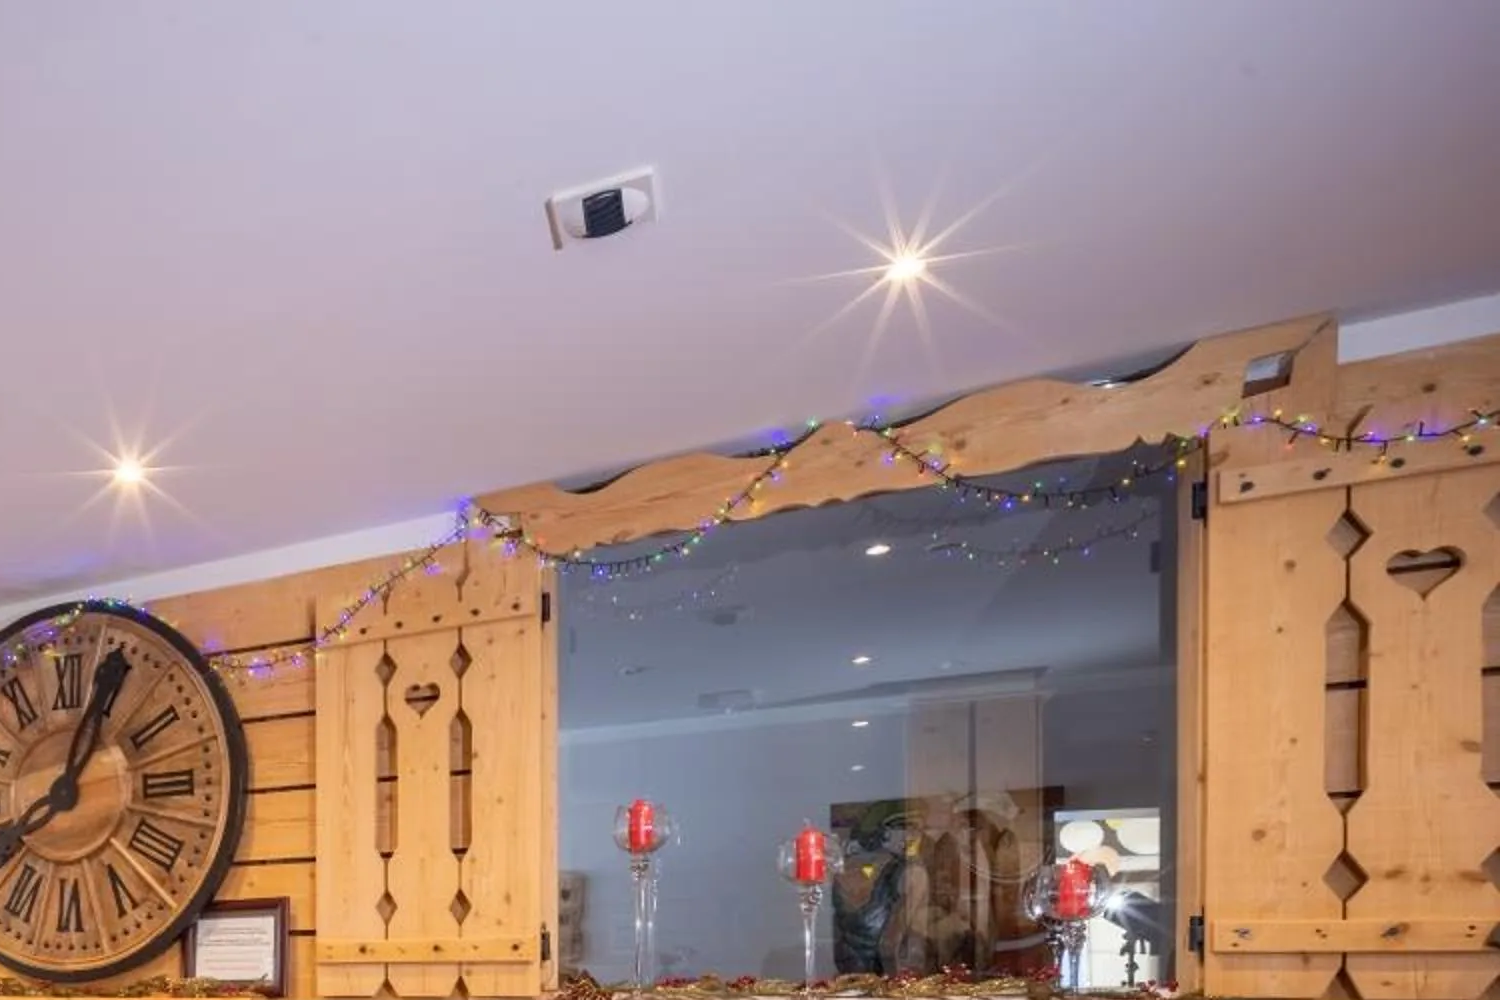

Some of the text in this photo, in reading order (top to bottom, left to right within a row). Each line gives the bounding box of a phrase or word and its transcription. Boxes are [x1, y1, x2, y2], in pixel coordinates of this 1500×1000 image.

[1, 675, 39, 731] XI
[52, 653, 84, 711] XII
[129, 704, 181, 752] II
[141, 769, 195, 799] III
[106, 862, 140, 919] V
